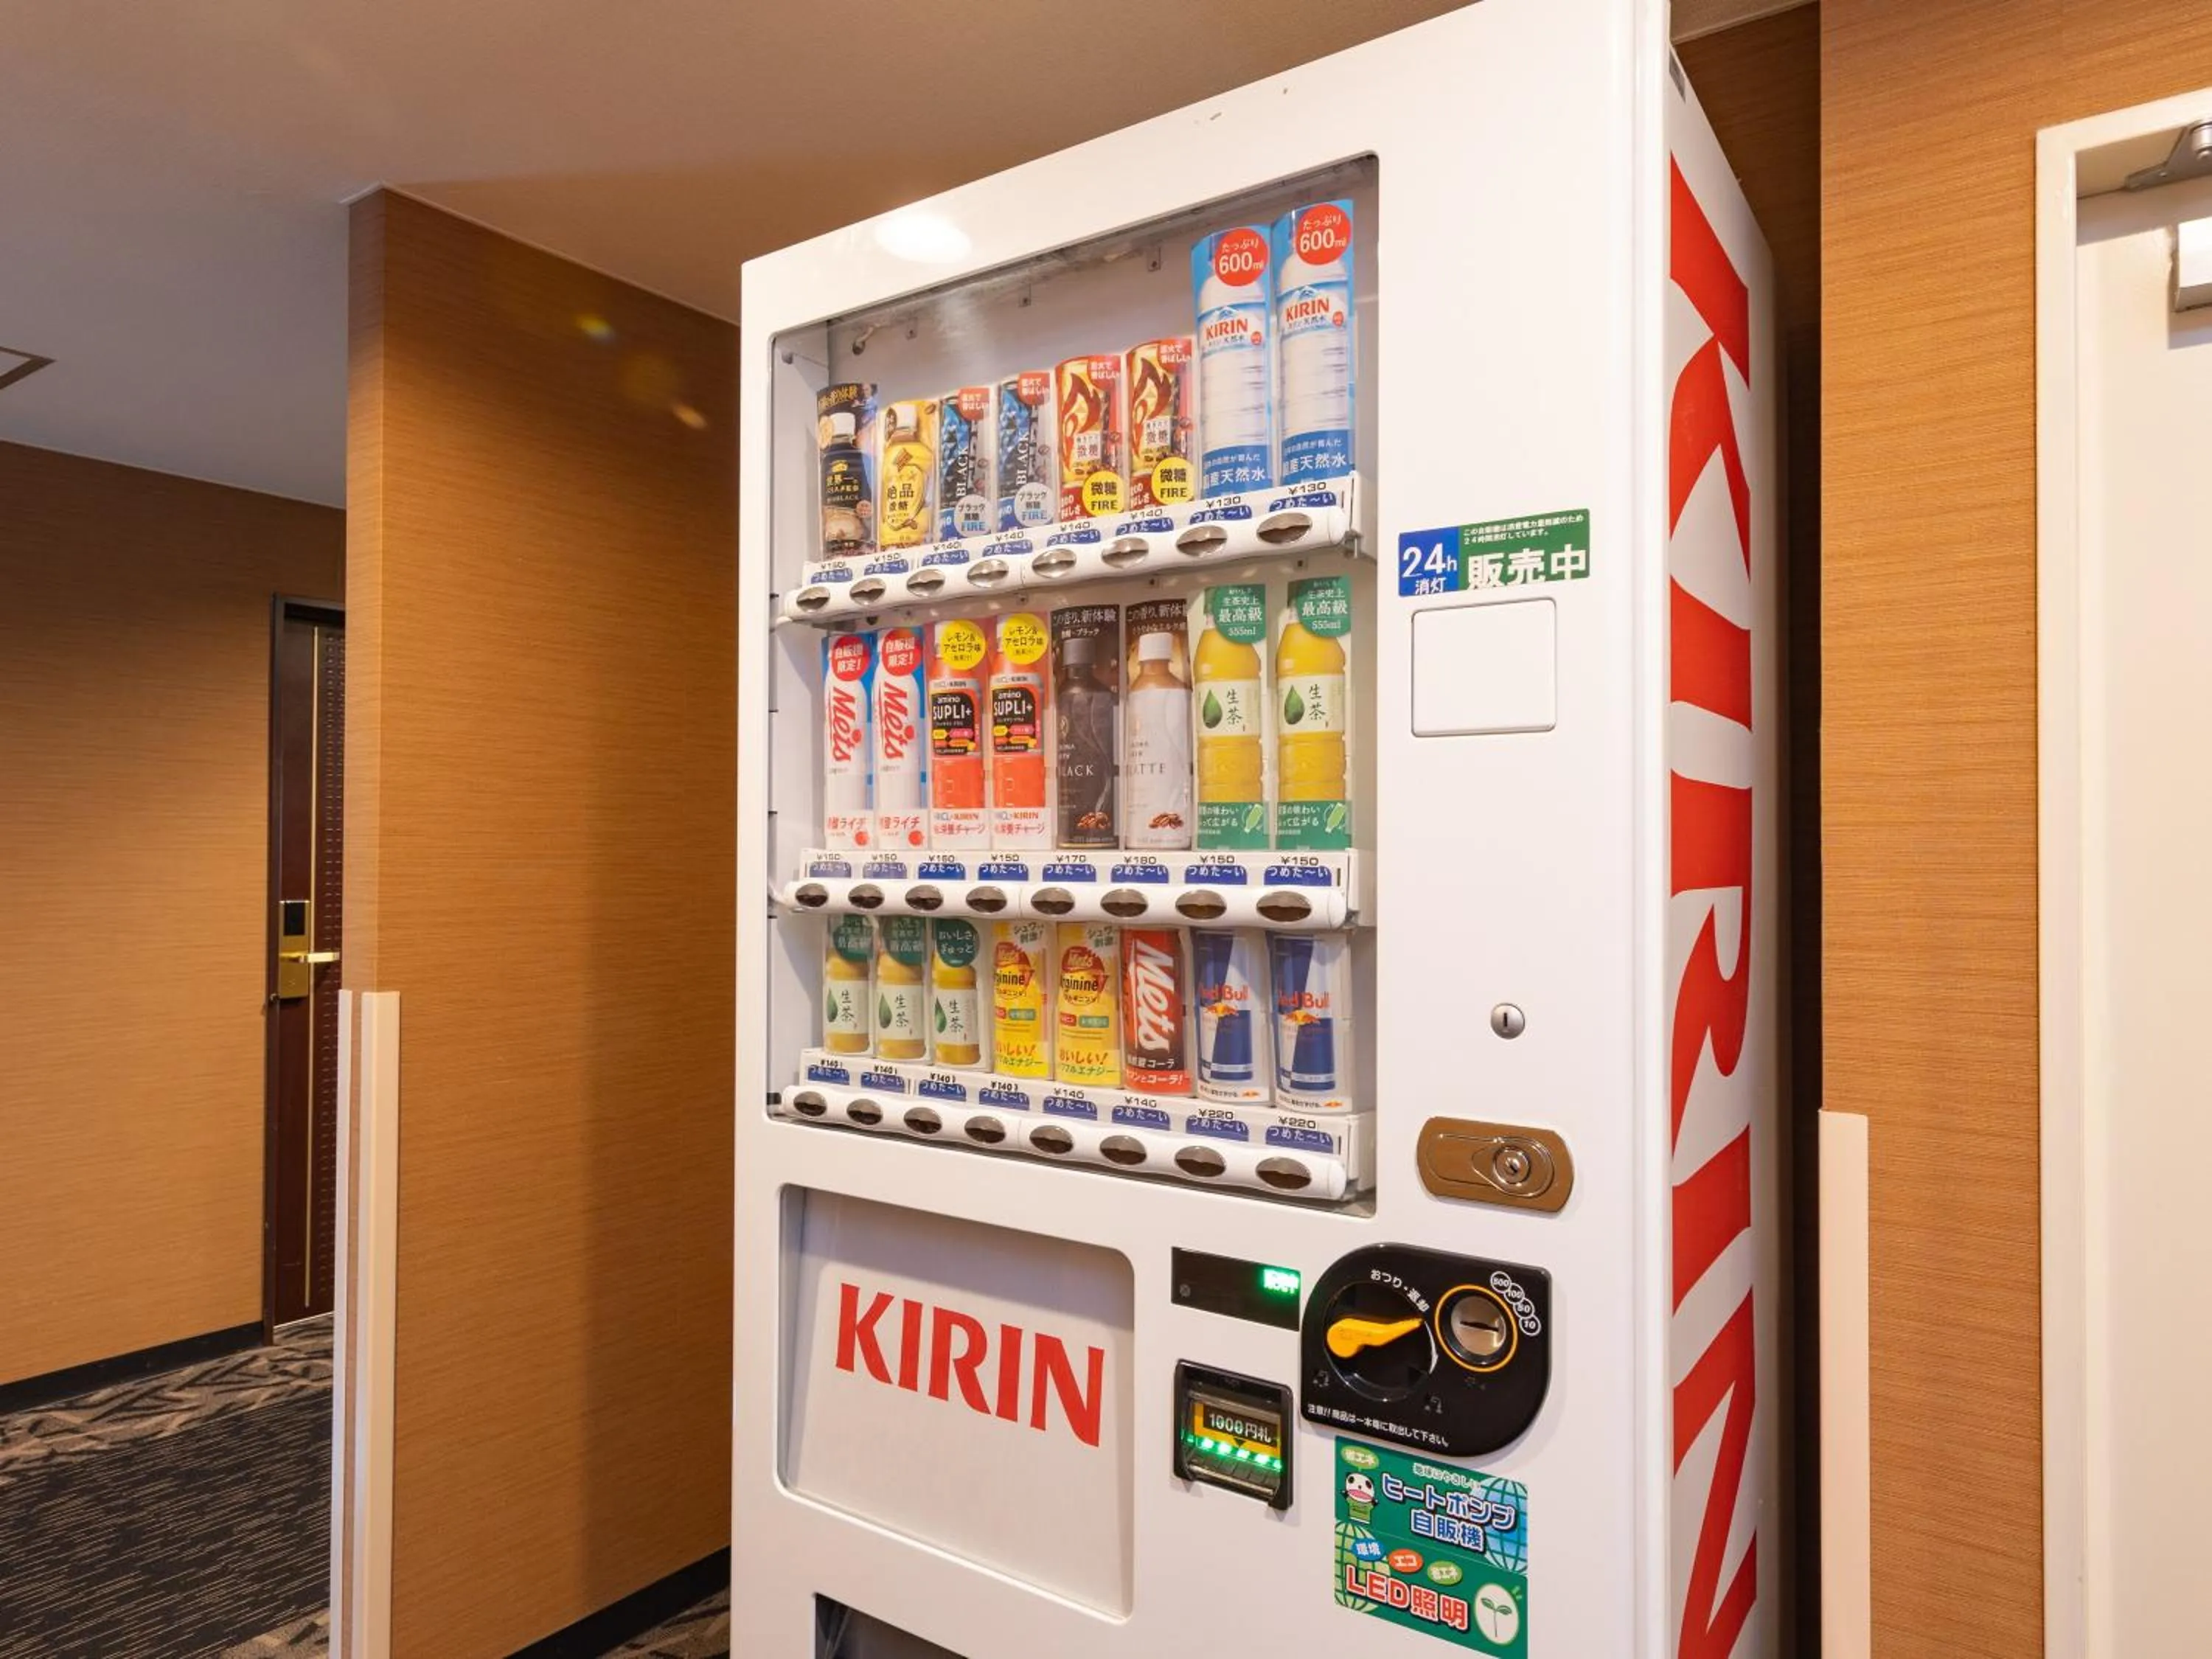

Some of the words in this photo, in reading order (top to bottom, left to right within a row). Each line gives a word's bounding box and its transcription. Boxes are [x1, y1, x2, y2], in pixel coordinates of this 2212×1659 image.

[1303, 214, 1342, 230] たっぷり
[1222, 238, 1259, 253] たっぷり
[1300, 229, 1346, 253] 600ml
[1219, 251, 1264, 274] 600ml
[1286, 297, 1329, 322] KIRIN
[1206, 318, 1248, 340] KIRIN
[1016, 433, 1029, 484] BLACK
[956, 448, 969, 497] BLACK
[1160, 468, 1186, 482] 微糖
[1091, 481, 1117, 496] 微糖
[1160, 487, 1188, 498] FIRE
[1288, 481, 1326, 495] ¥130
[1018, 492, 1048, 501] ブラック
[1206, 496, 1241, 508] ¥130
[959, 503, 986, 512] ブラック
[1091, 500, 1118, 510] FIRE
[1130, 509, 1163, 520] ¥140
[961, 521, 985, 531] FIRE
[1060, 521, 1091, 532] ¥140
[996, 531, 1024, 542] ¥140
[1402, 543, 1458, 578] 24h
[1467, 543, 1587, 590] 販売中
[1308, 588, 1346, 599] 生茶史上
[1415, 577, 1447, 595] 消灯
[1222, 596, 1259, 606] 生茶史上
[1302, 601, 1348, 616] 最高級
[1218, 606, 1262, 623] 最高級
[1228, 625, 1256, 636] 555ml
[1312, 620, 1341, 630] 555ml
[943, 644, 981, 653] アセロラ味
[1005, 637, 1043, 647] アセロラ味
[937, 695, 961, 704] amino
[998, 690, 1021, 700] amino
[1309, 684, 1326, 720] 生茶
[933, 704, 973, 720] SUPLI+
[994, 699, 1033, 716] SUPLI+
[1227, 688, 1243, 725] 生茶
[832, 686, 856, 762] Mets
[884, 681, 908, 759] Mets
[991, 854, 1019, 862] ¥150
[1057, 855, 1086, 863] ¥170
[1200, 855, 1235, 864] ¥150
[1281, 856, 1318, 866] ¥150
[1669, 151, 1757, 1659] KIRIN
[940, 944, 974, 955] ぎゅっと
[1135, 938, 1175, 1053] Mets
[1222, 984, 1249, 1001] Bull
[841, 989, 855, 1023] 生茶
[1303, 992, 1329, 1009] Bull
[895, 993, 909, 1028] 生茶
[949, 999, 964, 1033] 生茶
[1054, 1088, 1085, 1099] ¥140
[1124, 1096, 1157, 1108] ¥140
[1199, 1108, 1234, 1119] ¥220
[1279, 1116, 1316, 1129] ¥220
[1492, 1277, 1509, 1287] 500
[1517, 1304, 1530, 1313] 50
[1524, 1319, 1536, 1329] 10
[835, 1282, 1105, 1447] KIRIN
[1208, 1411, 1272, 1443] 1000円札
[1382, 1472, 1516, 1530] ヒートポンプ
[1411, 1509, 1485, 1552] 自販機
[1356, 1541, 1382, 1557] 環境
[1393, 1554, 1418, 1568] エコ
[1346, 1564, 1468, 1631] LED照明
